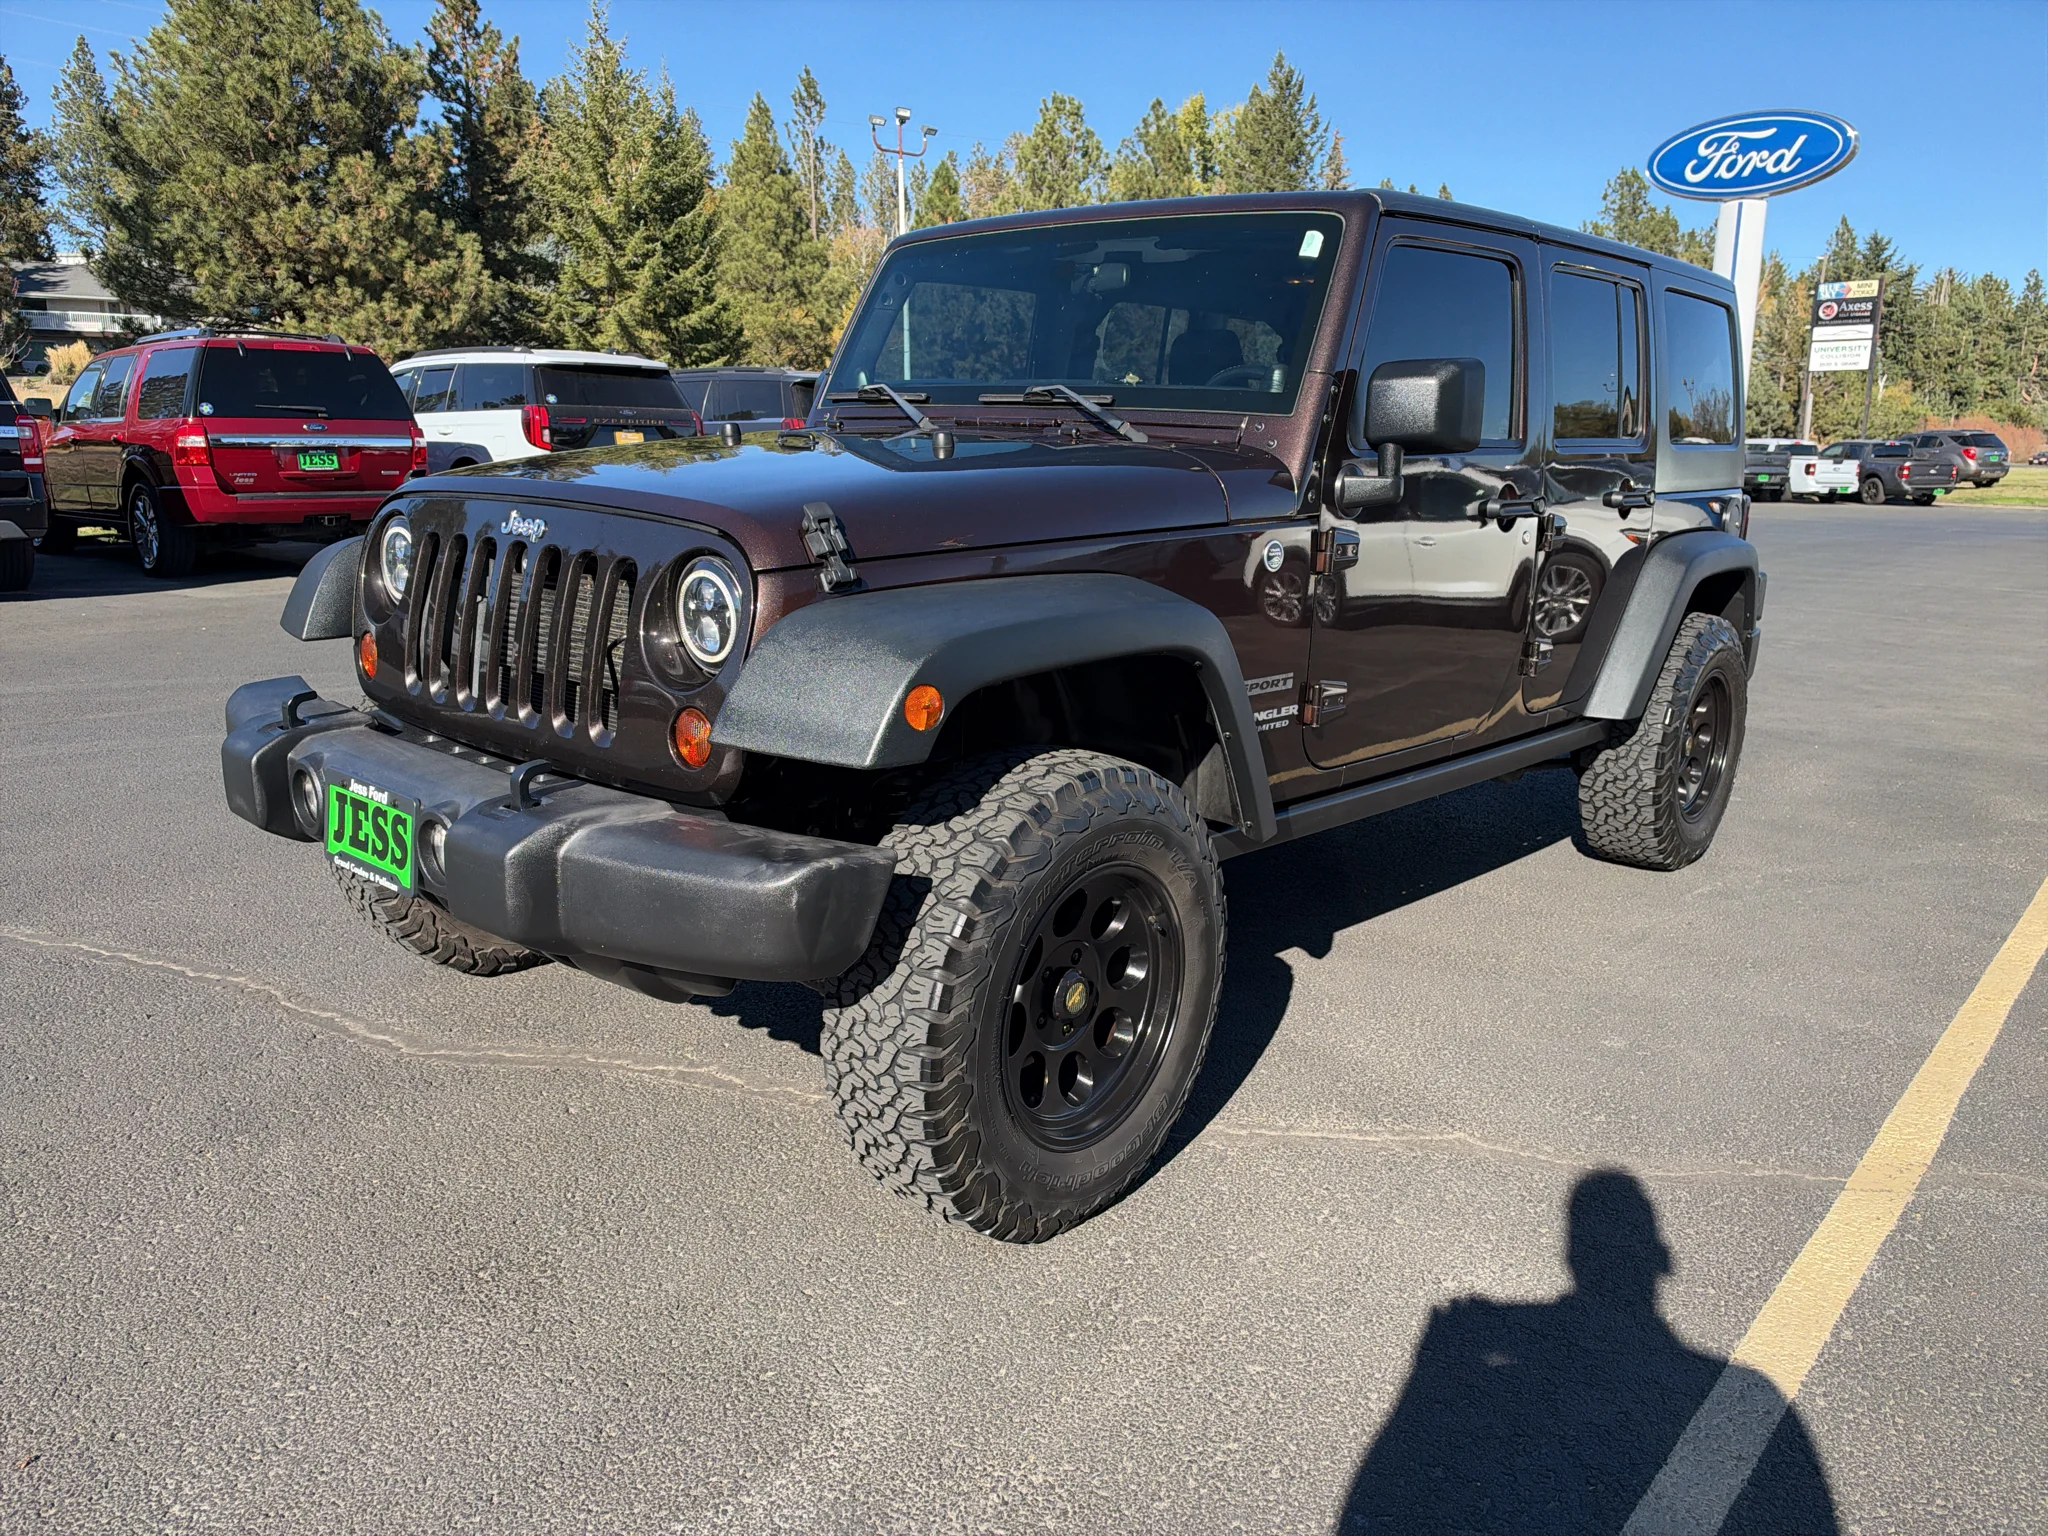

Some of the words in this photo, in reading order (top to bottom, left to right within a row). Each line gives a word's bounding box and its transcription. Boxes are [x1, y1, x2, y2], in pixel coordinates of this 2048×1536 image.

[1684, 128, 1807, 183] Ford
[1840, 301, 1873, 311] Axess
[1814, 345, 1868, 353] UNIVERSITY
[302, 454, 335, 466] JESS
[501, 510, 548, 543] Jeep
[1254, 705, 1299, 721] NGLER
[1257, 719, 1289, 732] MITED
[349, 779, 368, 797] Jess
[369, 786, 389, 805] Ford
[333, 791, 408, 870] JESS
[1018, 1093, 1170, 1192] BFGoodrich
